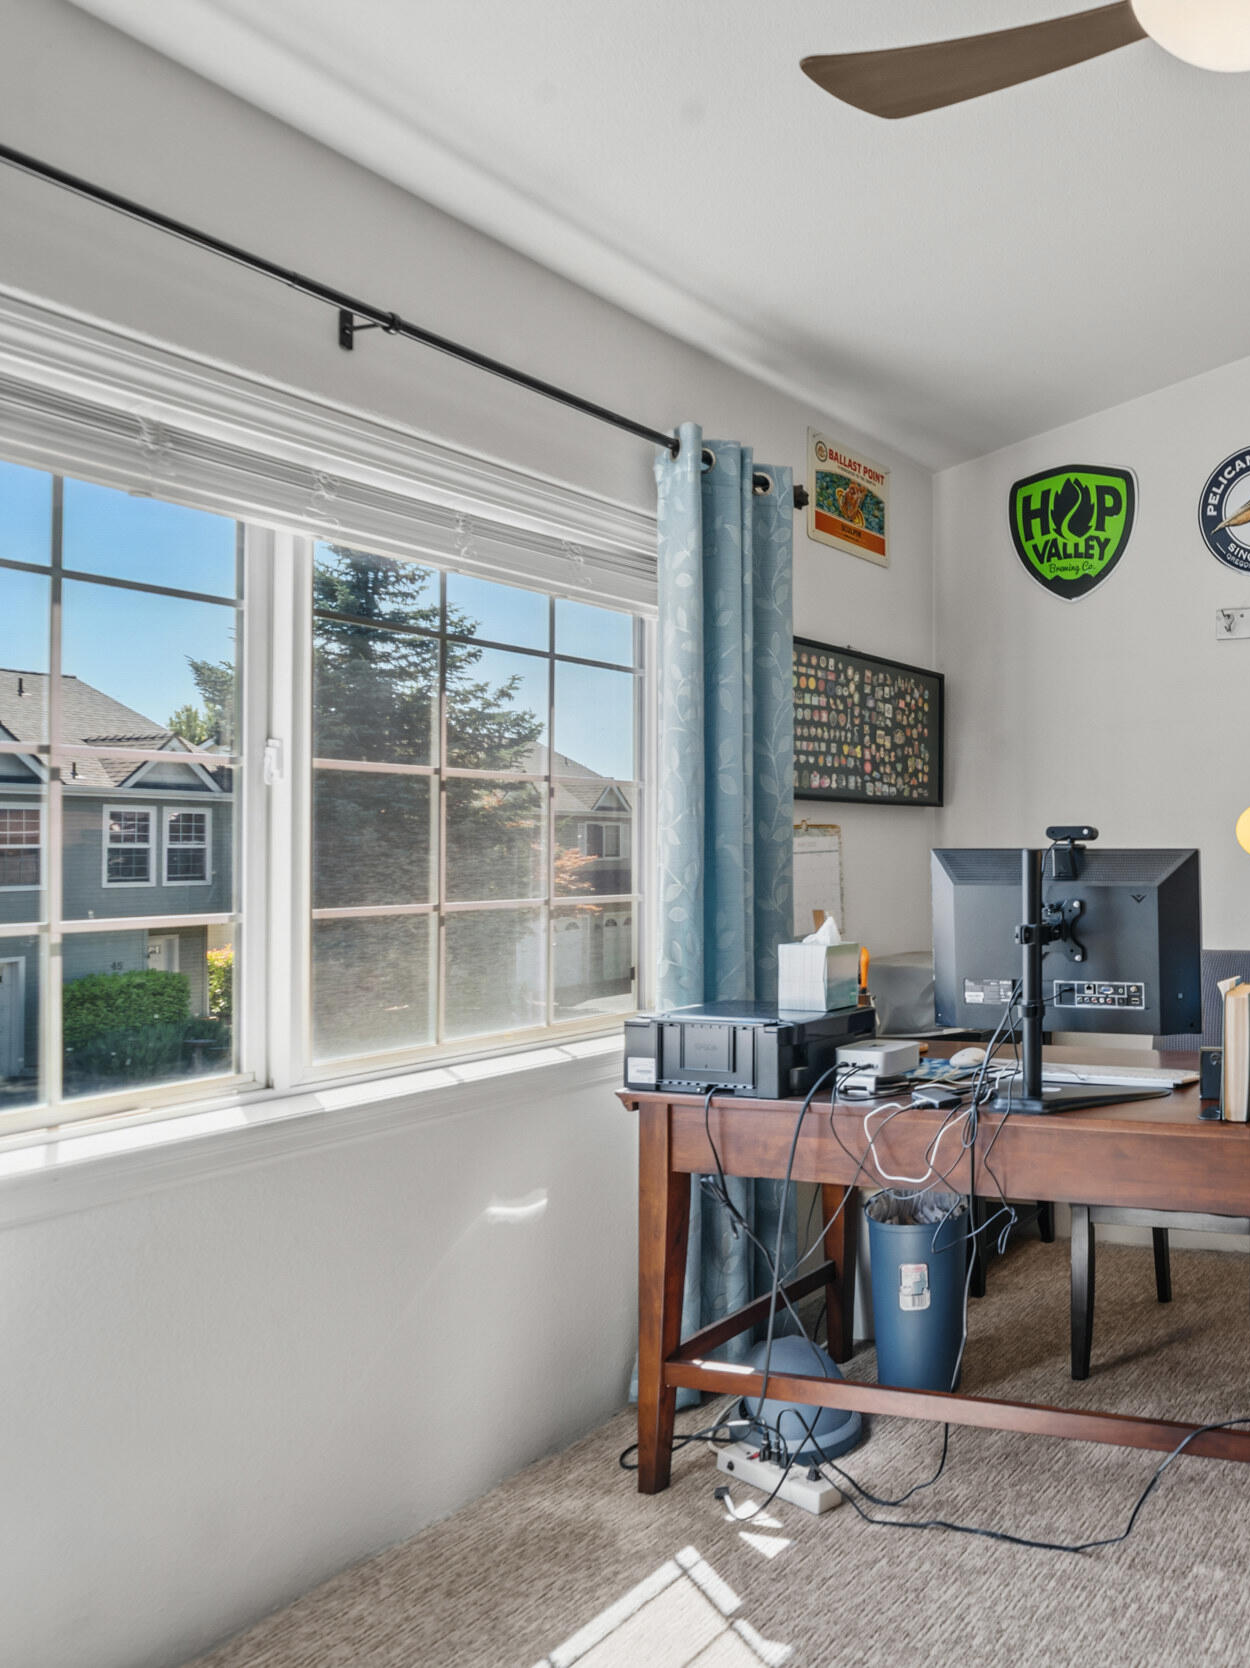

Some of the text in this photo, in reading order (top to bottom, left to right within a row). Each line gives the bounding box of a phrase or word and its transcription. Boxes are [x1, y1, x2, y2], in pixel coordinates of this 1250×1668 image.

[828, 448, 862, 474] BALLAST
[863, 466, 885, 486] POINT
[1032, 535, 1111, 564] VALLEY
[1049, 563, 1080, 575] Brewing
